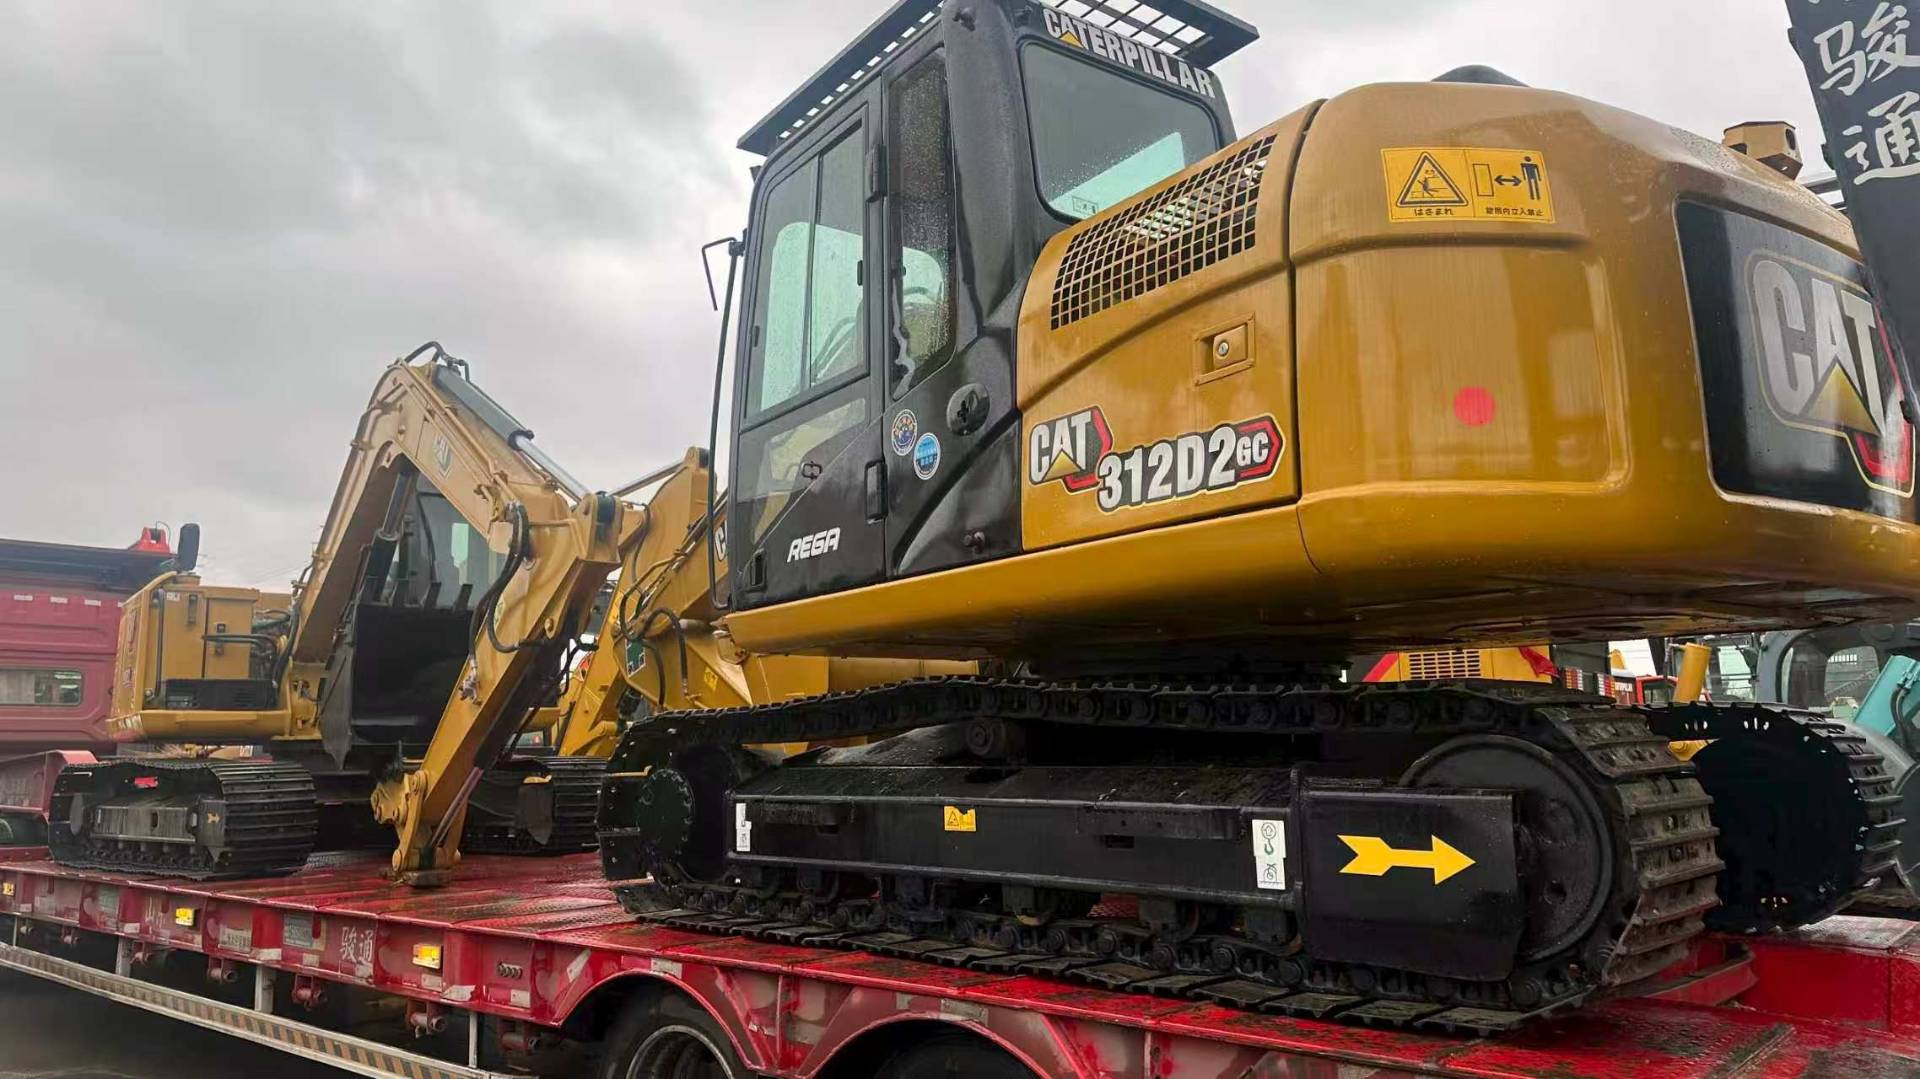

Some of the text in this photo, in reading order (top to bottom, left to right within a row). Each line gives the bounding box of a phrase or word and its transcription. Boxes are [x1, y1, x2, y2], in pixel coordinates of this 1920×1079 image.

[1043, 8, 1215, 98] CATERPILLAR
[1414, 207, 1454, 217] はさまれ
[1753, 260, 1886, 438] CAT
[1031, 410, 1092, 483] CAT
[340, 926, 373, 965] 骏通
